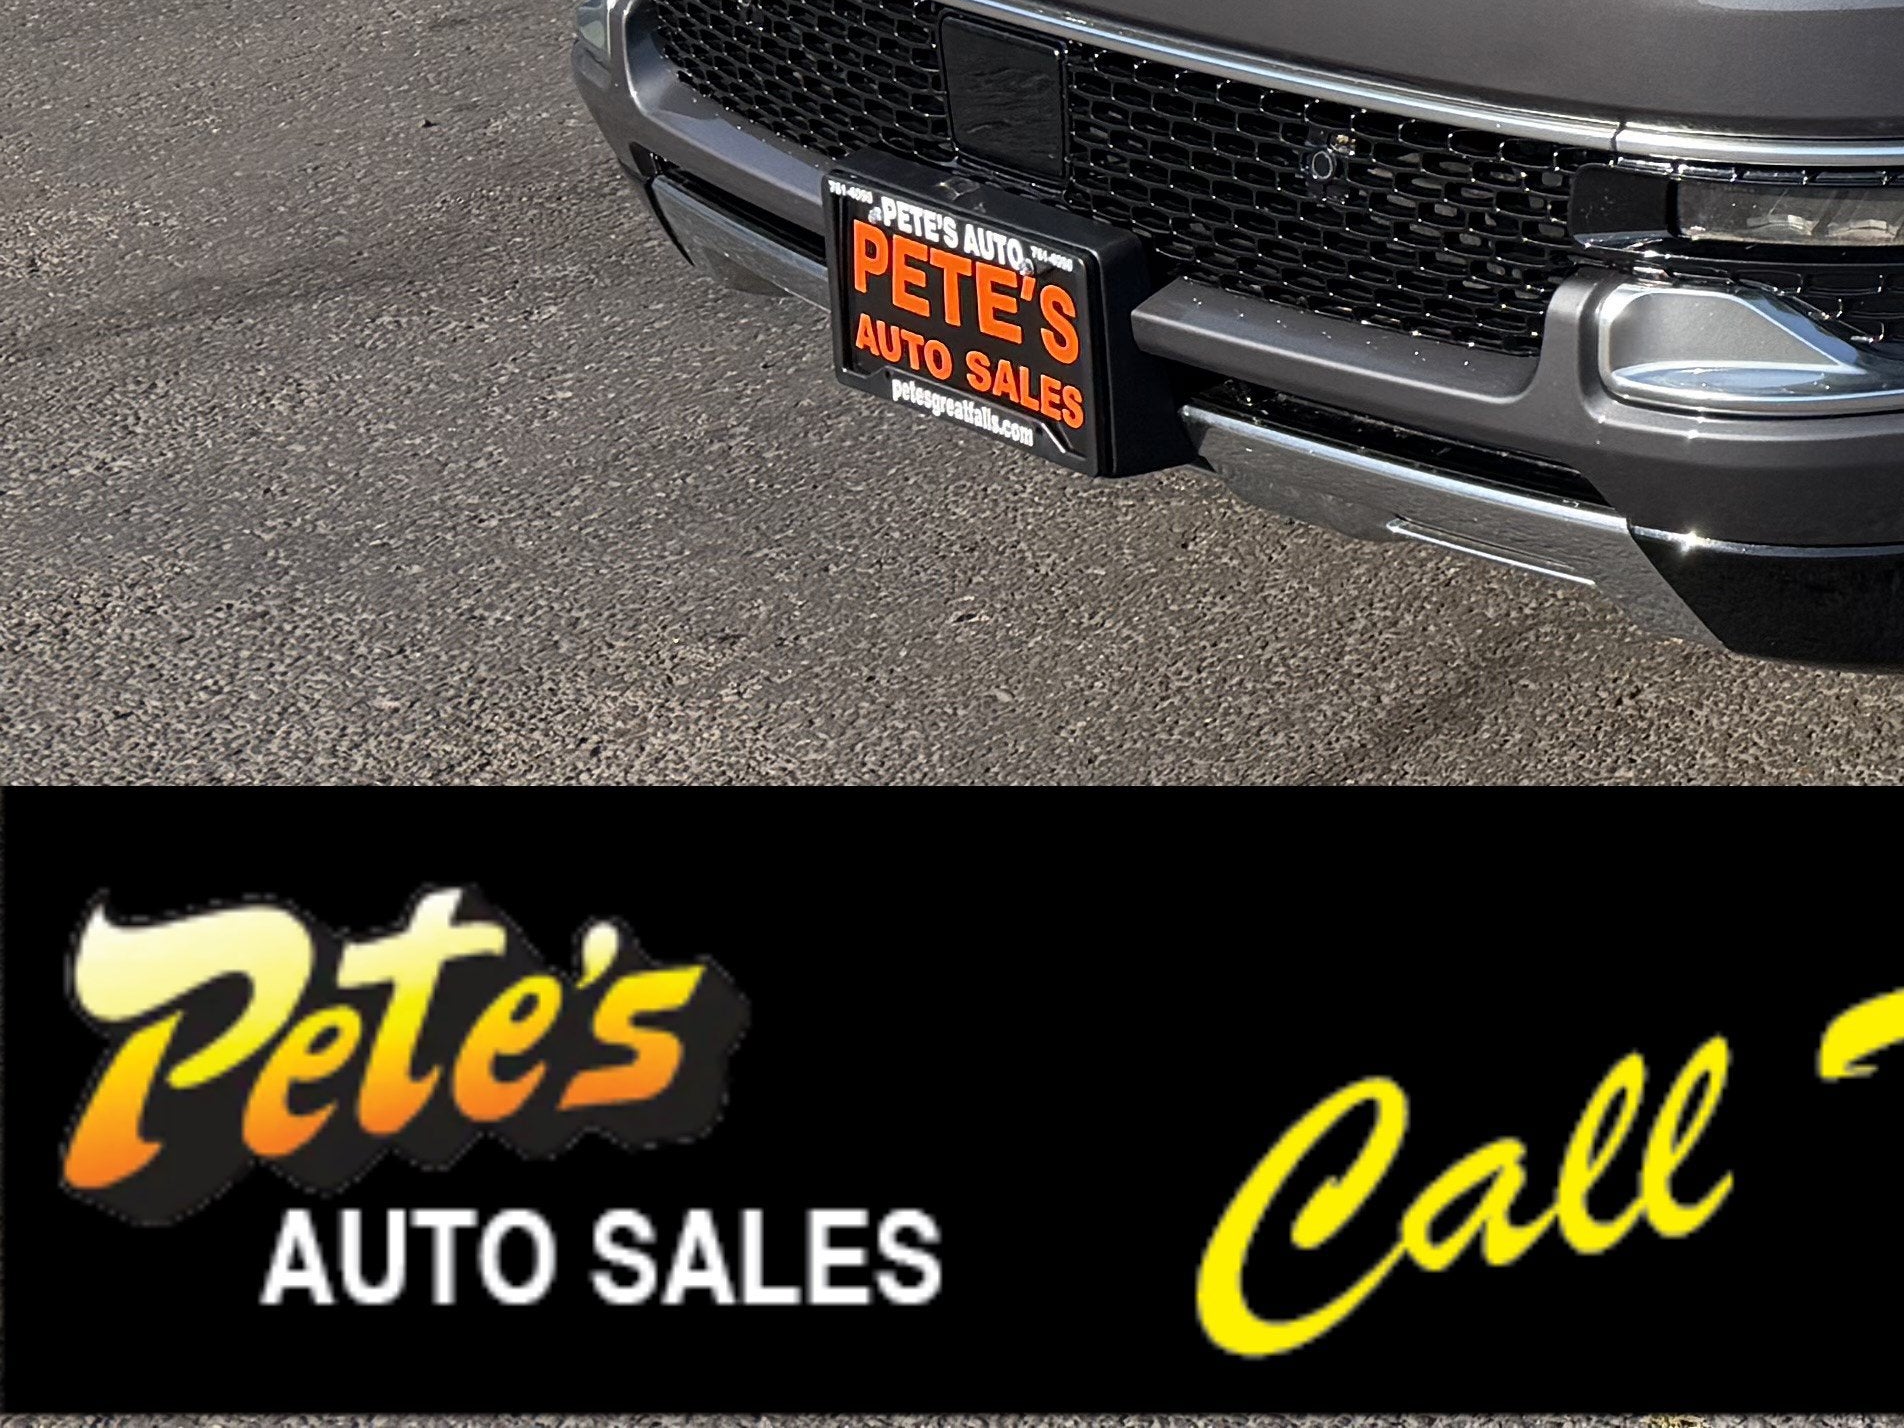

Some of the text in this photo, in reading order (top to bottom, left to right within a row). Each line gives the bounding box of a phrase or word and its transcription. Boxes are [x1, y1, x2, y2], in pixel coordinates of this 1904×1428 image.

[880, 196, 1025, 272] PETE'S AUTO
[853, 219, 1080, 365] PETE'S
[855, 313, 1084, 429] AUTO SALES
[892, 378, 1034, 447] petesgreatfalls.com
